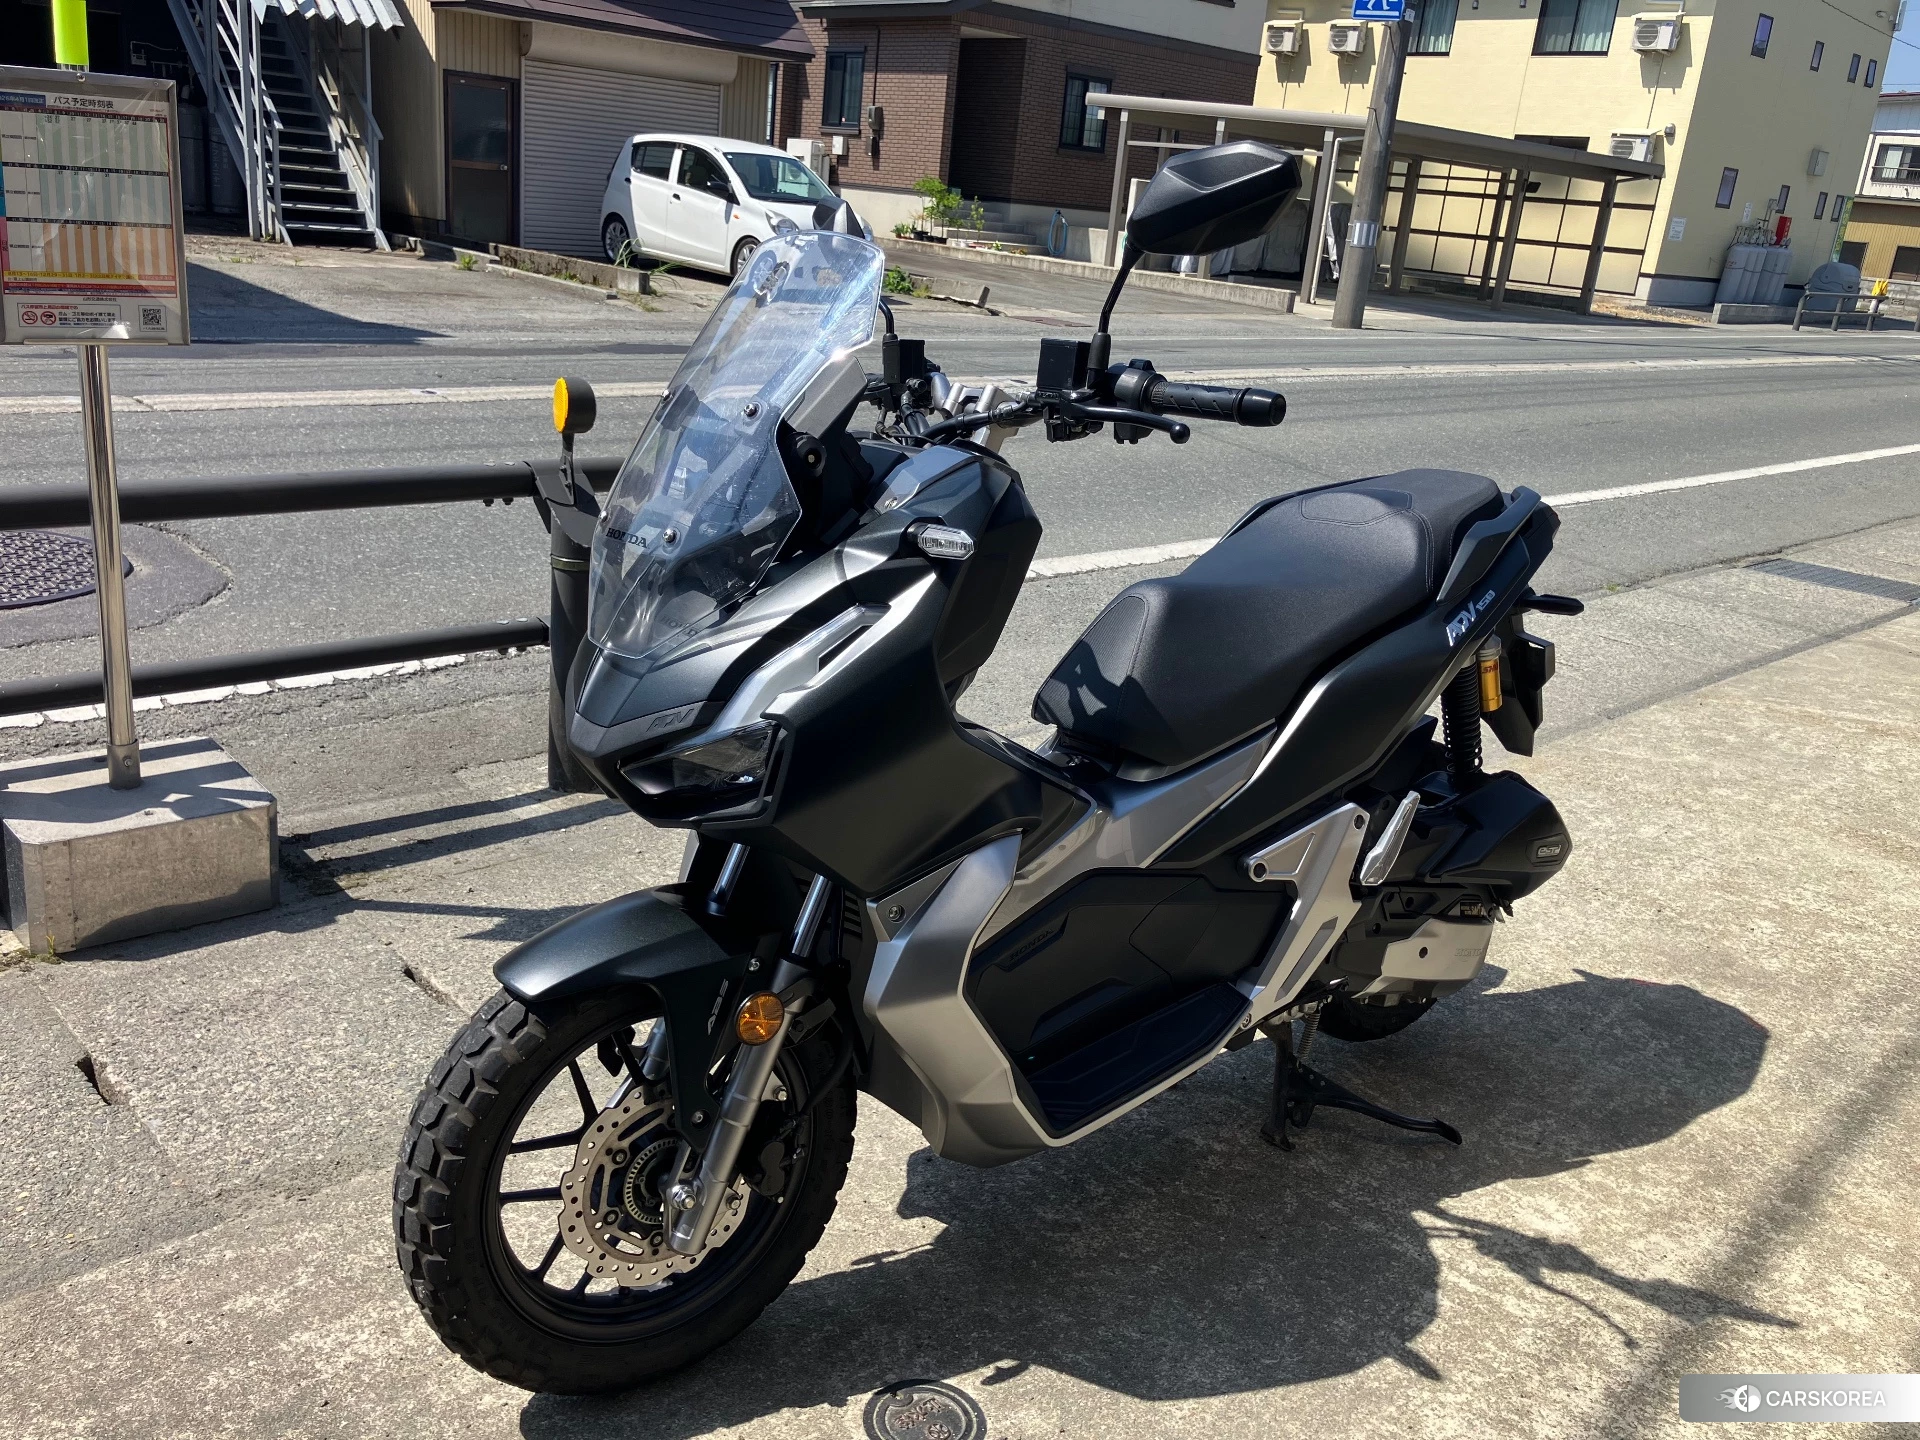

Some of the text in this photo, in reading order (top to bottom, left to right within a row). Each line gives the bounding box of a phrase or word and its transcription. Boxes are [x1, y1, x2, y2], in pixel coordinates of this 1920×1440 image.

[53, 96, 114, 109] バス予定時刻表
[605, 527, 648, 549] HONDA
[1446, 589, 1496, 647] ADV 150
[707, 978, 729, 1036] ABS
